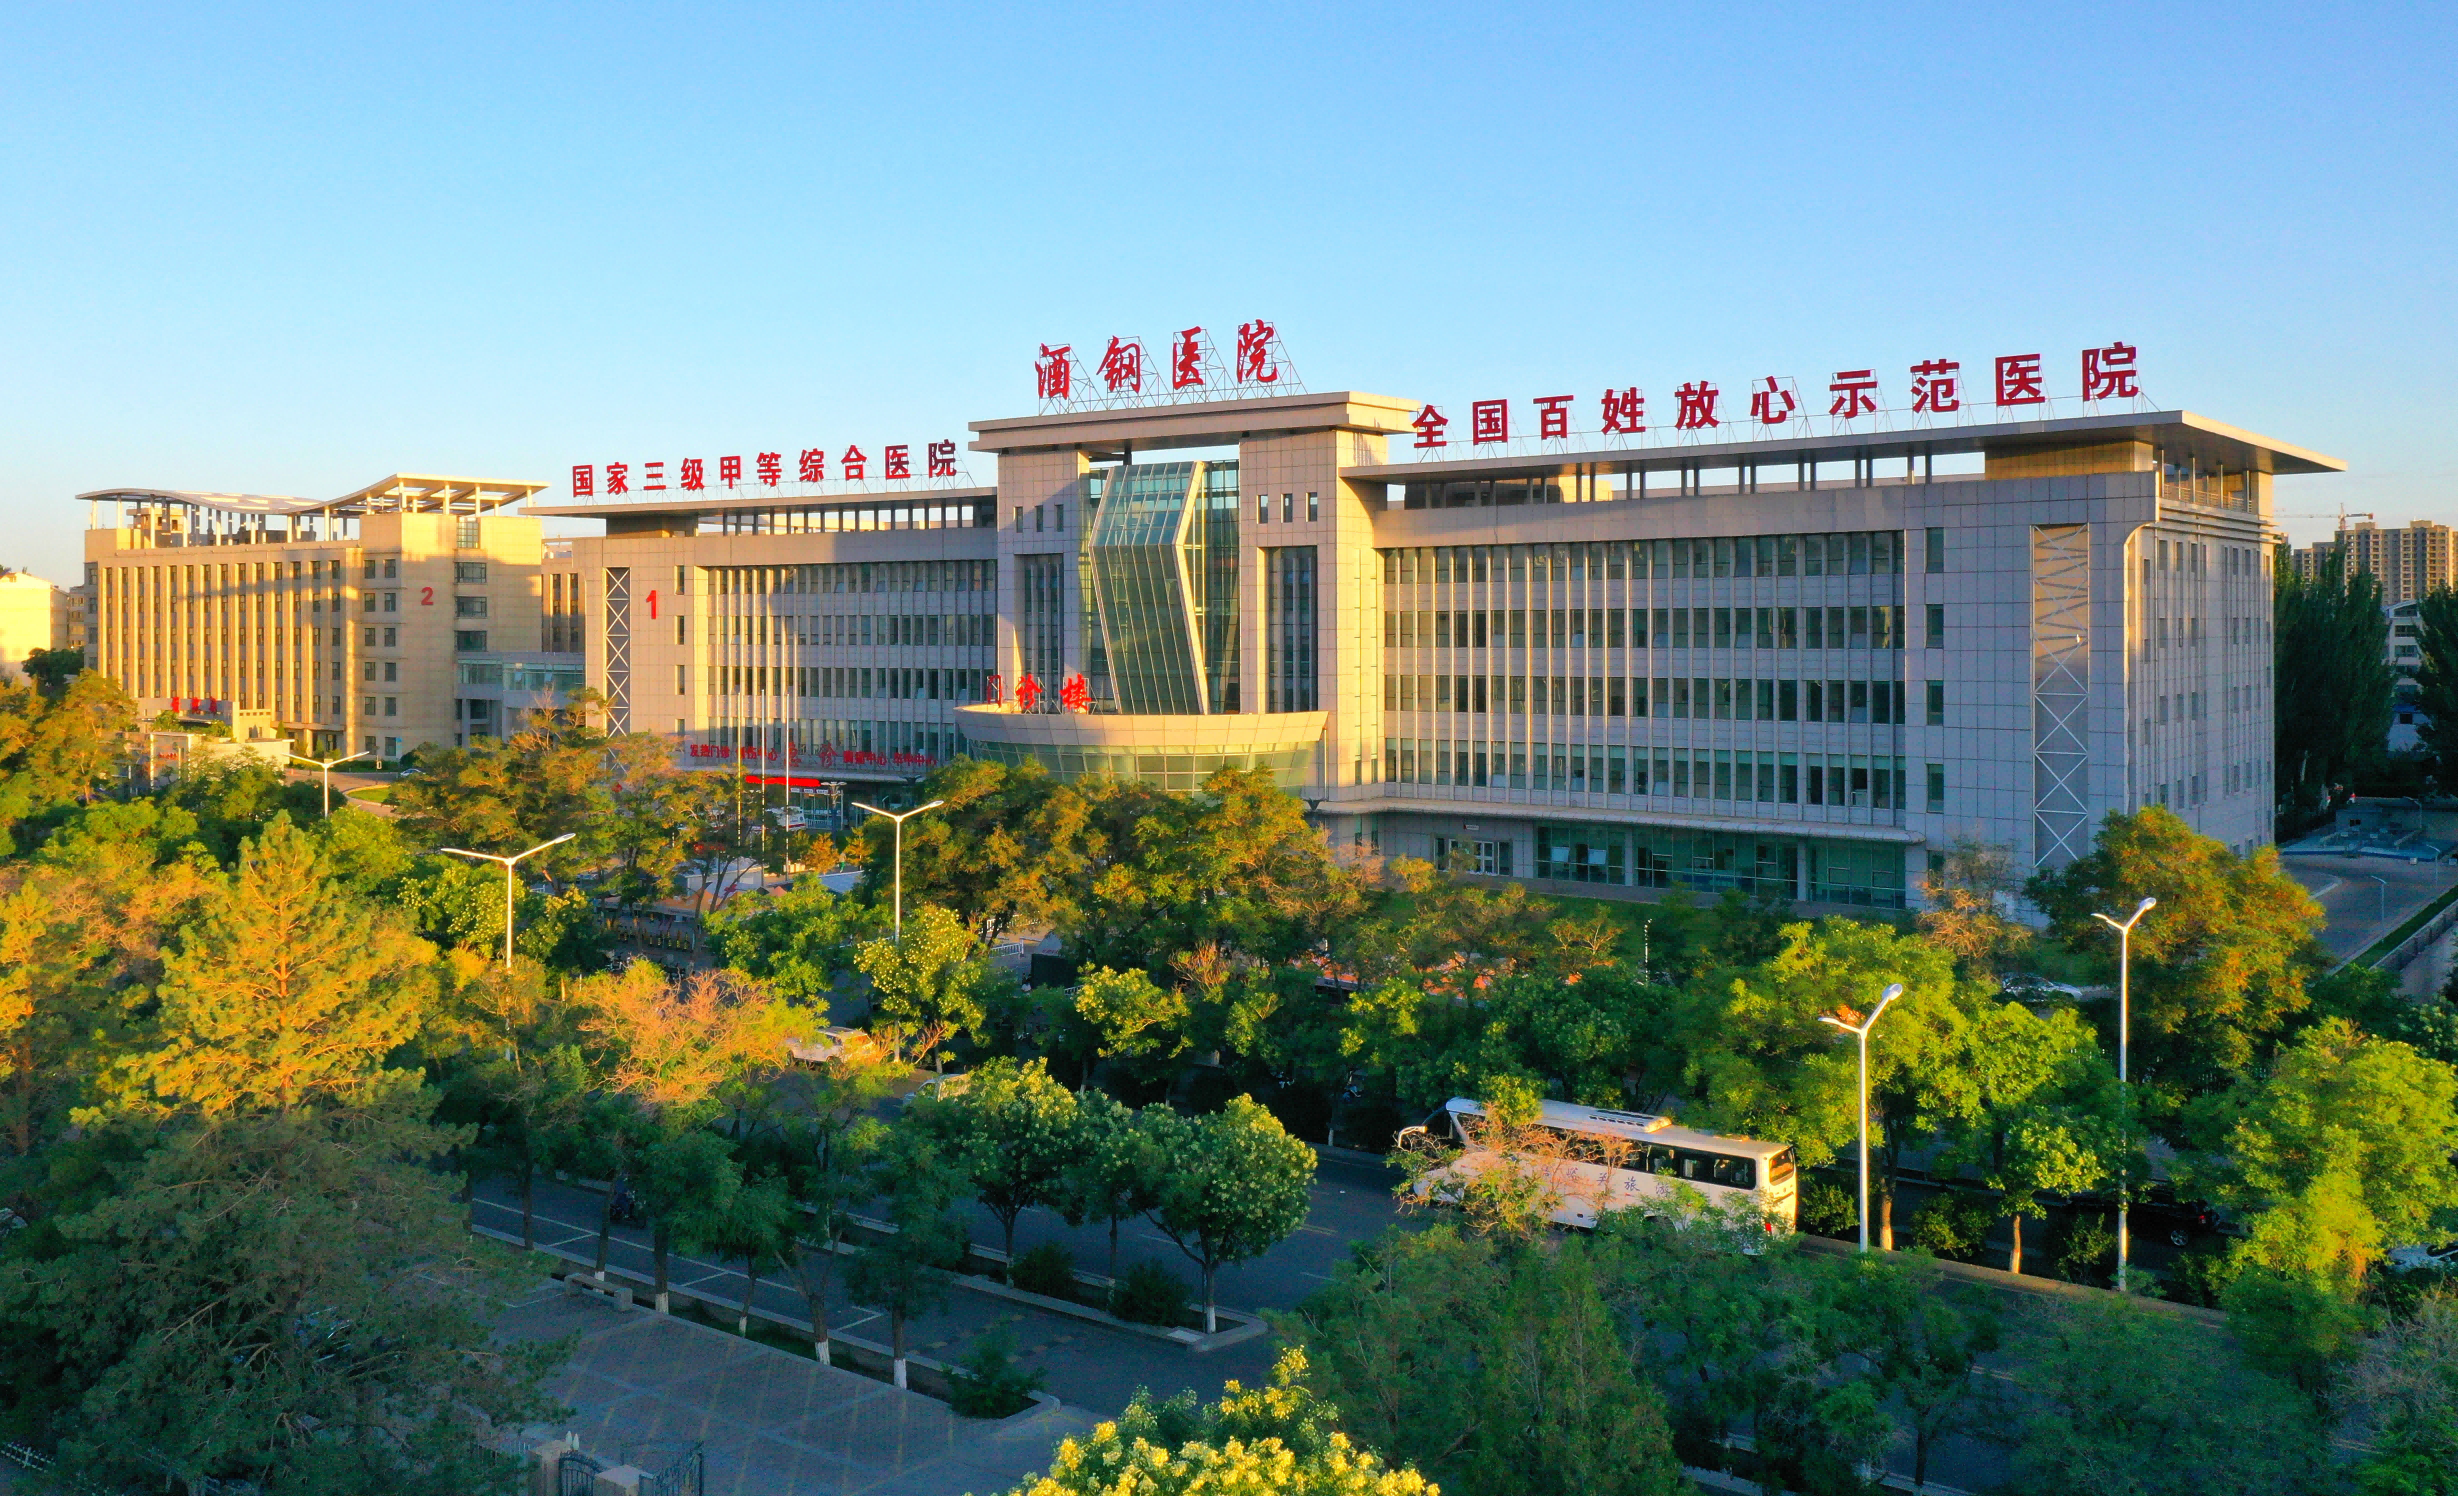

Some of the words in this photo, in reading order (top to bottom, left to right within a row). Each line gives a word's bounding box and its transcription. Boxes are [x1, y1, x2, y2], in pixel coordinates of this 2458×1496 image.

[1035, 319, 1279, 400] 酒钢医院
[1412, 341, 2140, 449] 全国百姓放心示范医院
[571, 439, 958, 498] 国家三级甲等综合医院
[420, 586, 435, 606] 2
[645, 589, 657, 620] 1
